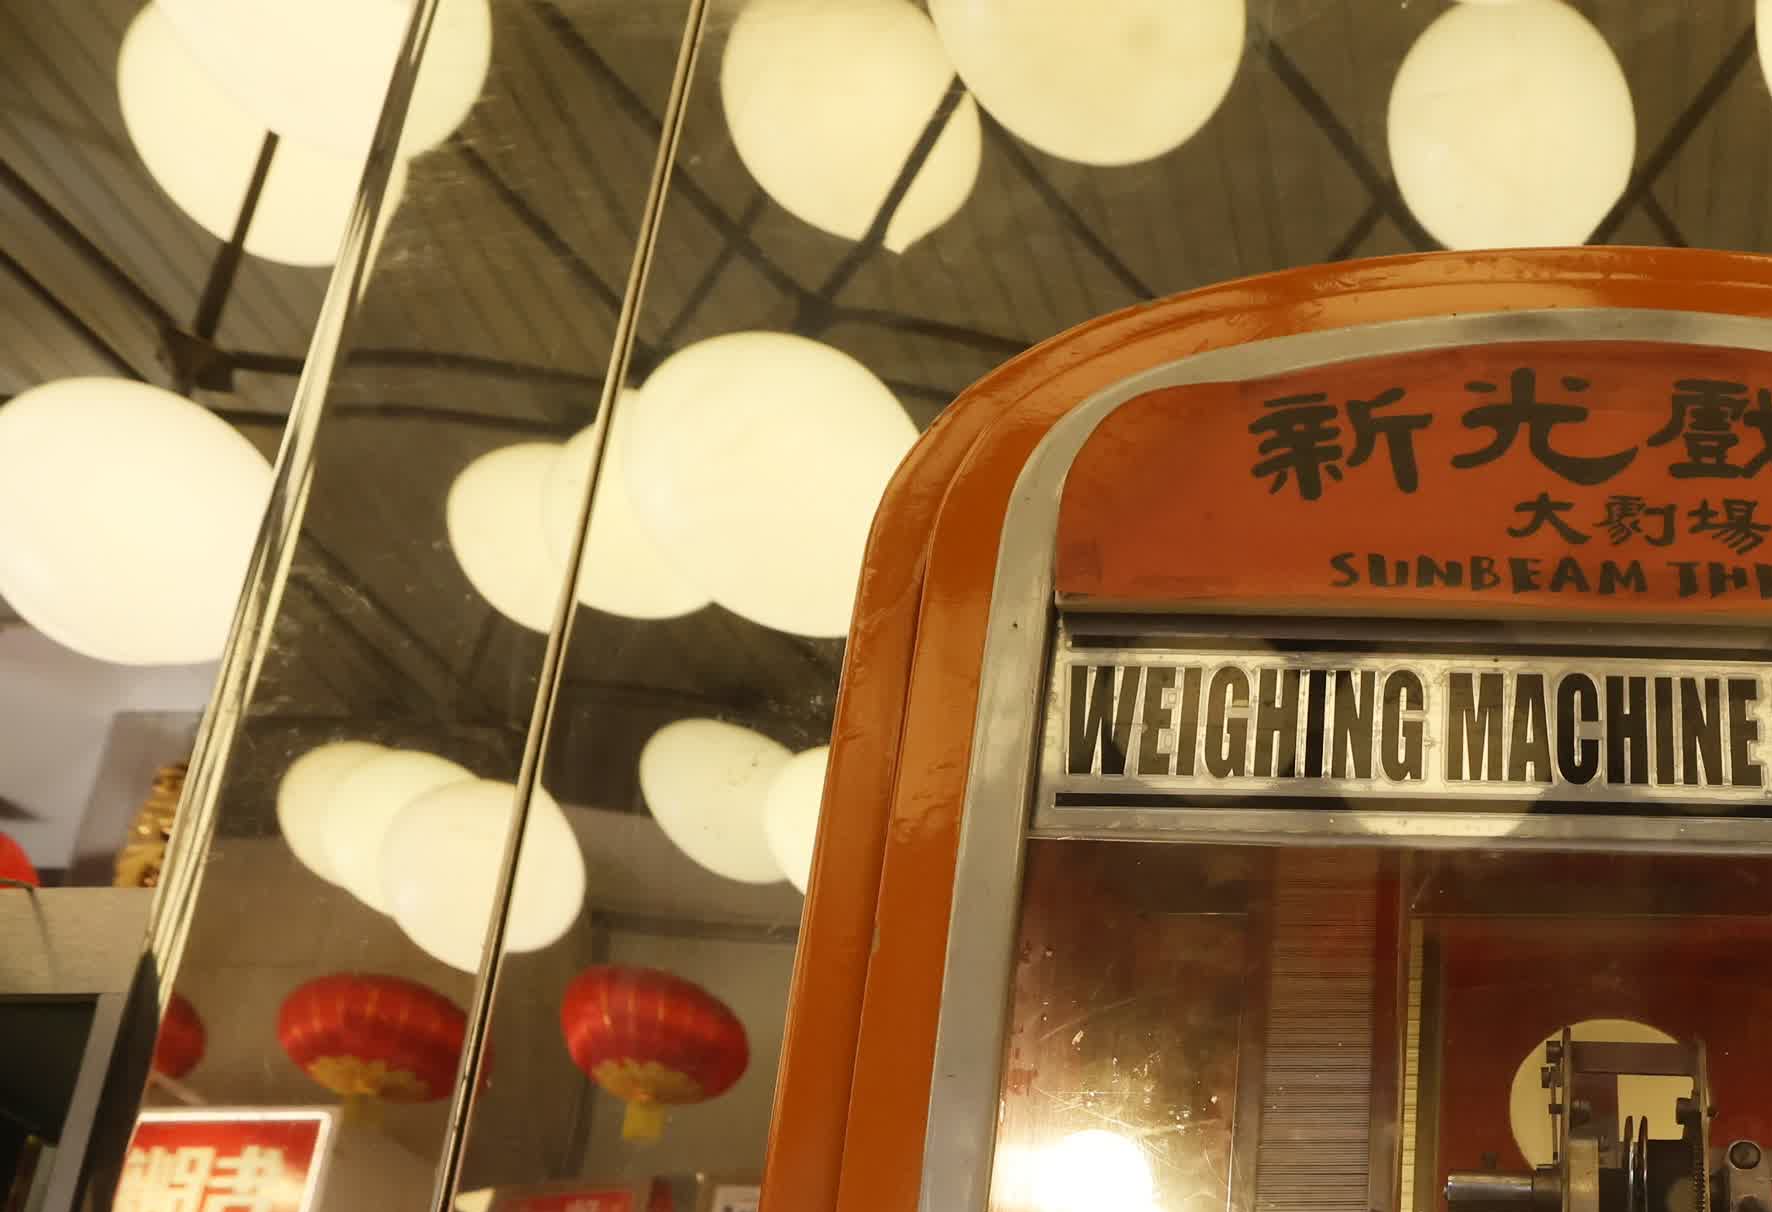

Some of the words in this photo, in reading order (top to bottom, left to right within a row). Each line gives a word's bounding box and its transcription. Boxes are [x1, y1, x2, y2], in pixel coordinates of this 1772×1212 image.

[1328, 552, 1648, 594] SUNBEAM
[1069, 664, 1425, 780] WEIGHING
[1448, 671, 1763, 787] MACHINE
